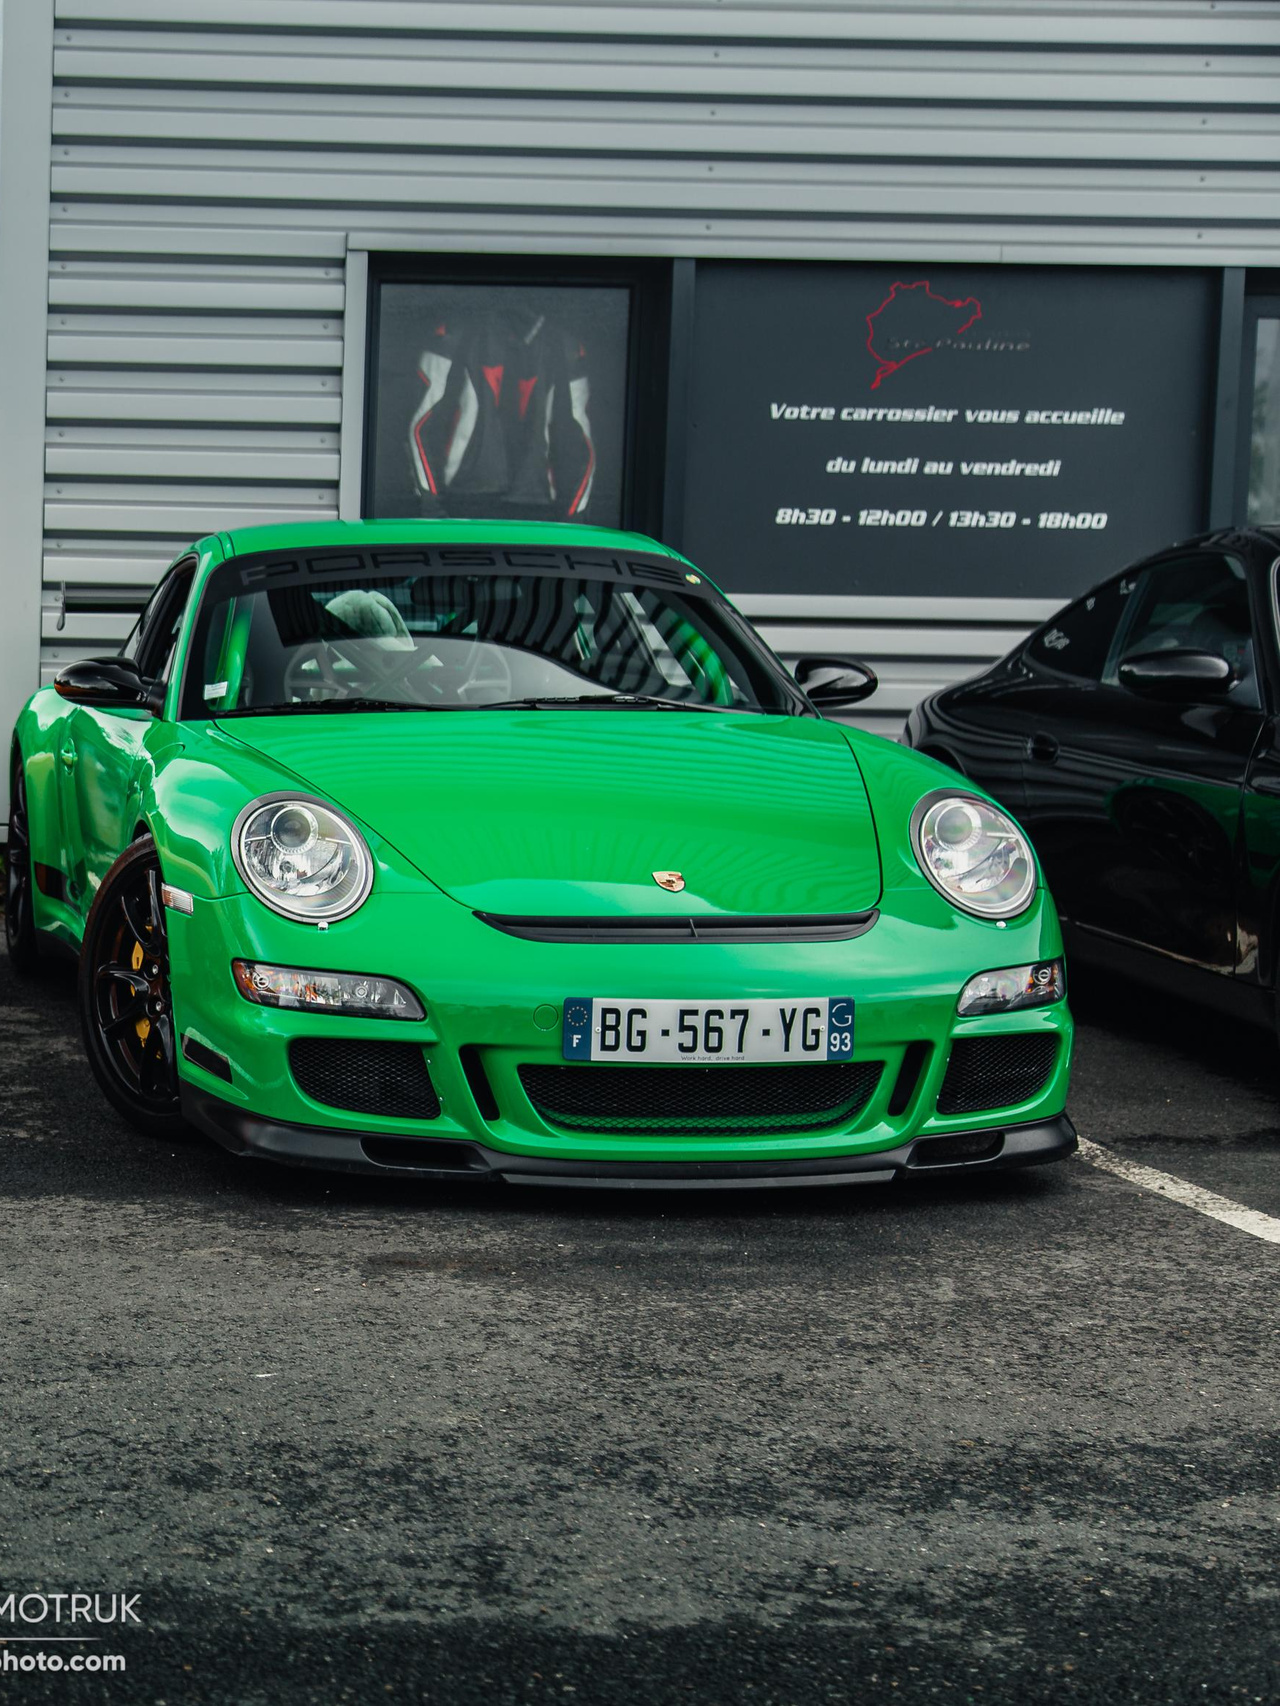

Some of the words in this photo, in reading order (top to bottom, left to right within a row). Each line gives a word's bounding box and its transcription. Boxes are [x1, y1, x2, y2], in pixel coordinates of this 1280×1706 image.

[770, 403, 835, 421] Votre
[840, 406, 958, 423] carrossier
[965, 409, 1020, 423] vous
[1024, 408, 1125, 425] accueille
[826, 457, 856, 474] du
[860, 457, 919, 475] lundi
[923, 460, 954, 475] au
[960, 460, 1062, 477] vendredi
[775, 508, 837, 526] 8h30
[858, 509, 927, 527] 12h00
[949, 510, 1016, 528] 13h30
[1037, 512, 1108, 530] 18h00
[240, 550, 685, 587] PORSCHE
[572, 1034, 582, 1048] F
[599, 1007, 821, 1054] BG-567-YG
[830, 1032, 851, 1052] 93
